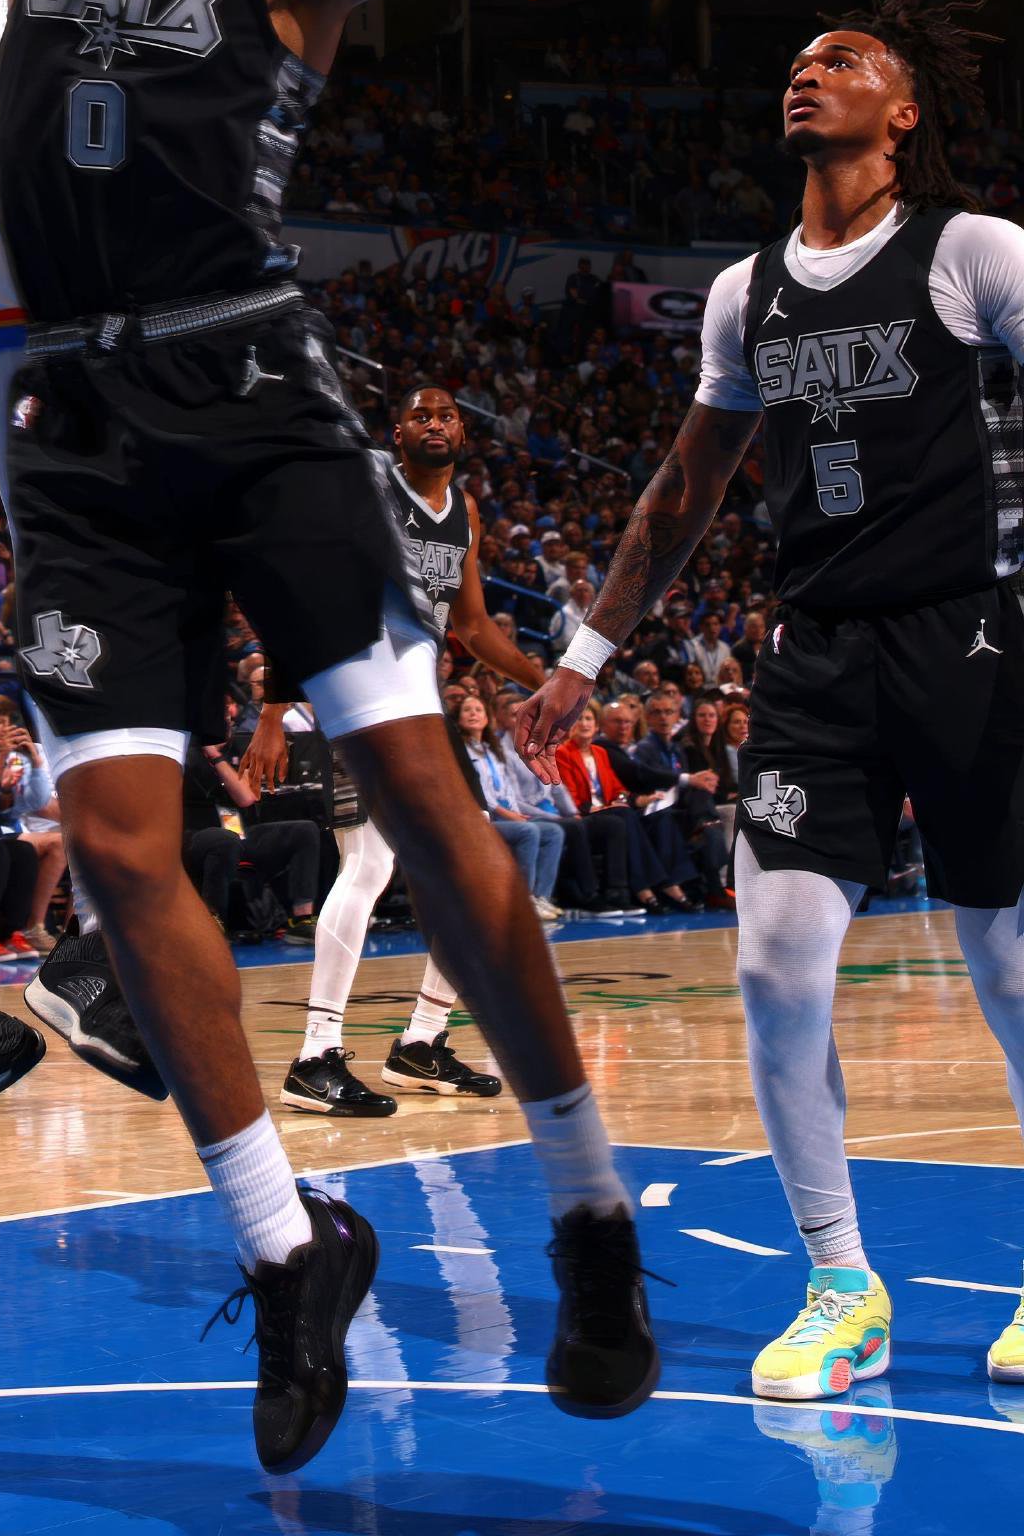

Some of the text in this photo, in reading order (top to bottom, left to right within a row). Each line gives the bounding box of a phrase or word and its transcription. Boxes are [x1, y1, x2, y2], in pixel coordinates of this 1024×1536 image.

[68, 79, 126, 170] 0
[755, 319, 919, 407] SATX
[811, 440, 865, 517] 5
